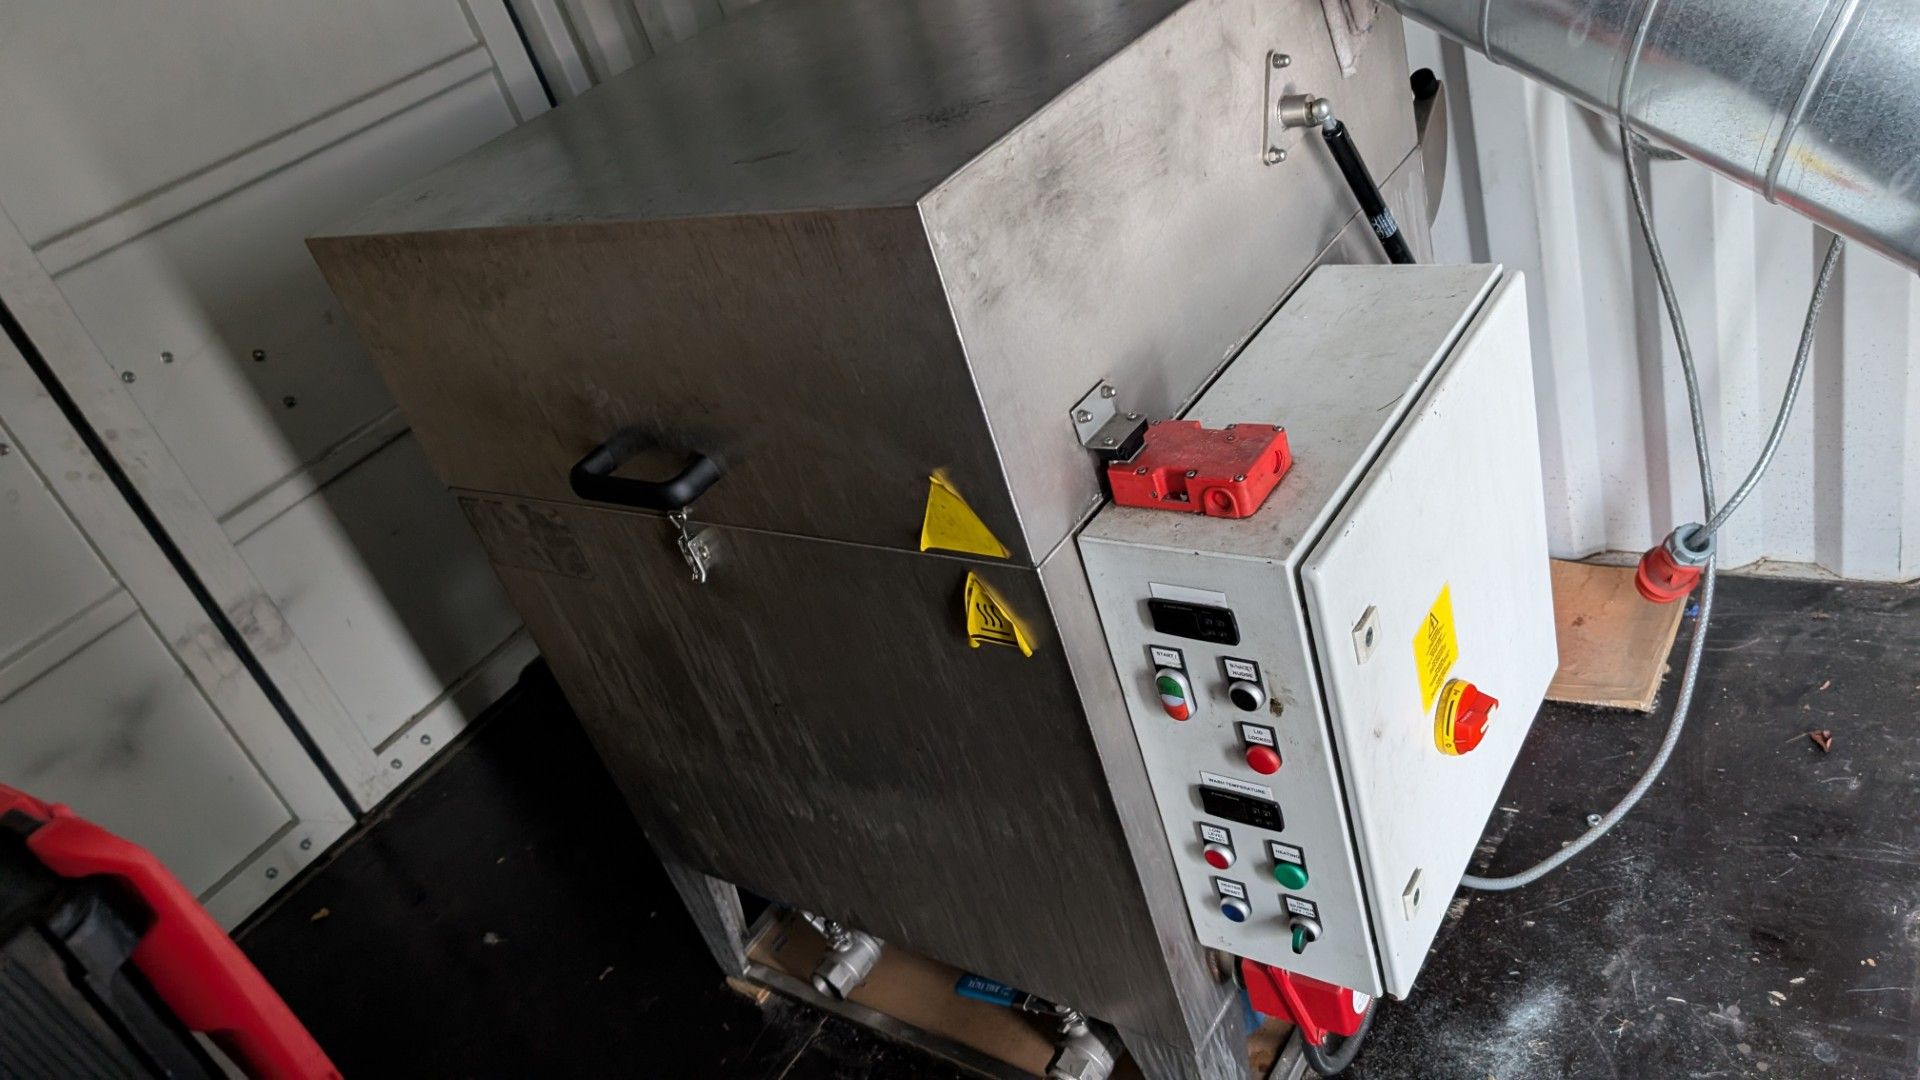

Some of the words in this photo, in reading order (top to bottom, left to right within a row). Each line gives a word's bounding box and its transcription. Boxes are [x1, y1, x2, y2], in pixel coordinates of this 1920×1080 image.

[1156, 650, 1174, 658] START
[1232, 670, 1254, 678] NUDGE
[1247, 734, 1271, 743] LOCKED
[1208, 777, 1224, 785] WASH
[1225, 781, 1265, 794] TEMPERATURE
[1275, 849, 1300, 859] HEATING
